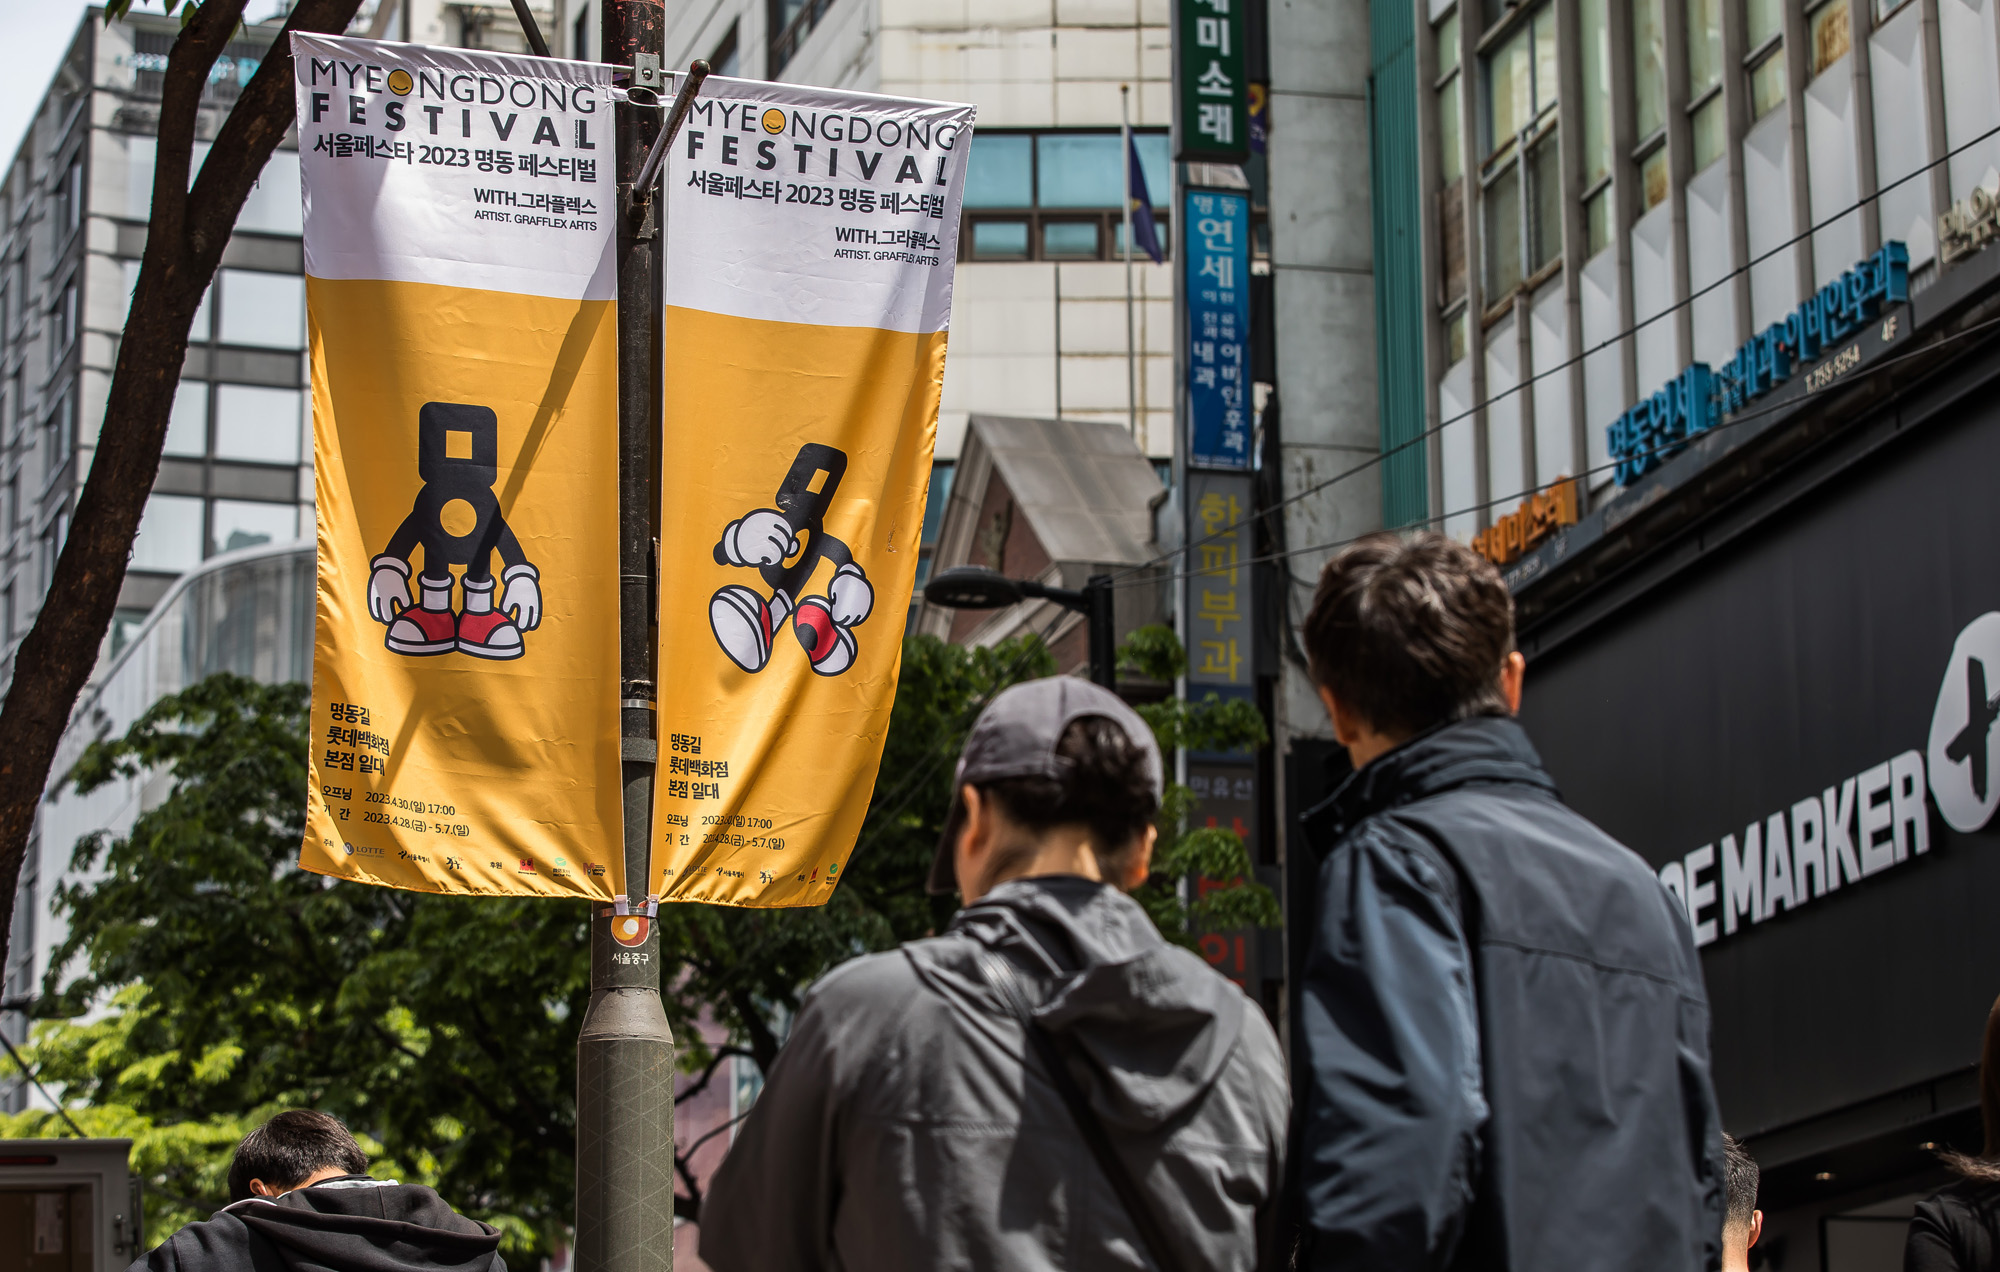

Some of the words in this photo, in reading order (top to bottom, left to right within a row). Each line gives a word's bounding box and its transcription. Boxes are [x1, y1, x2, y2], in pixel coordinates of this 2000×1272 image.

[311, 57, 596, 114] MYEONGDONG
[1194, 0, 1233, 144] 미소래
[312, 92, 596, 150] FESTIVAL
[688, 100, 955, 151] MYEONGDONG
[313, 132, 414, 165] 서울페스타
[418, 144, 470, 168] 2023
[475, 149, 515, 175] 명동
[518, 153, 597, 183] 페스티벌
[687, 131, 947, 187] FESTIVAL
[474, 188, 597, 215] WITH.그라플렉스
[687, 170, 782, 204] 서울페스타
[786, 183, 834, 207] 2023
[839, 187, 877, 213] 명동
[880, 191, 945, 219] 페스티벌
[474, 210, 512, 224] ARTIST.
[515, 213, 567, 229] GRAFFLEX
[569, 218, 597, 231] ARTS
[1938, 186, 2000, 264] 민유
[834, 249, 871, 261] ARTIST.
[915, 255, 939, 267] ARTS
[1197, 218, 1234, 289] 연세
[330, 702, 371, 726] 명동길
[326, 725, 390, 756] 롯데백화점
[670, 733, 702, 754] 명동길
[324, 749, 355, 770] 본점
[358, 755, 386, 776] 일대
[669, 756, 729, 778] 롯데백화점
[322, 785, 352, 801] 오프닝
[428, 803, 455, 816] 17:00
[668, 779, 688, 799] 본점
[691, 782, 720, 800] 일대
[666, 814, 689, 827] 오프닝
[747, 817, 772, 829] 17:00
[356, 846, 385, 854] LOTTE
[1720, 749, 1930, 936] MARKER
[611, 952, 649, 965] 서울중구
